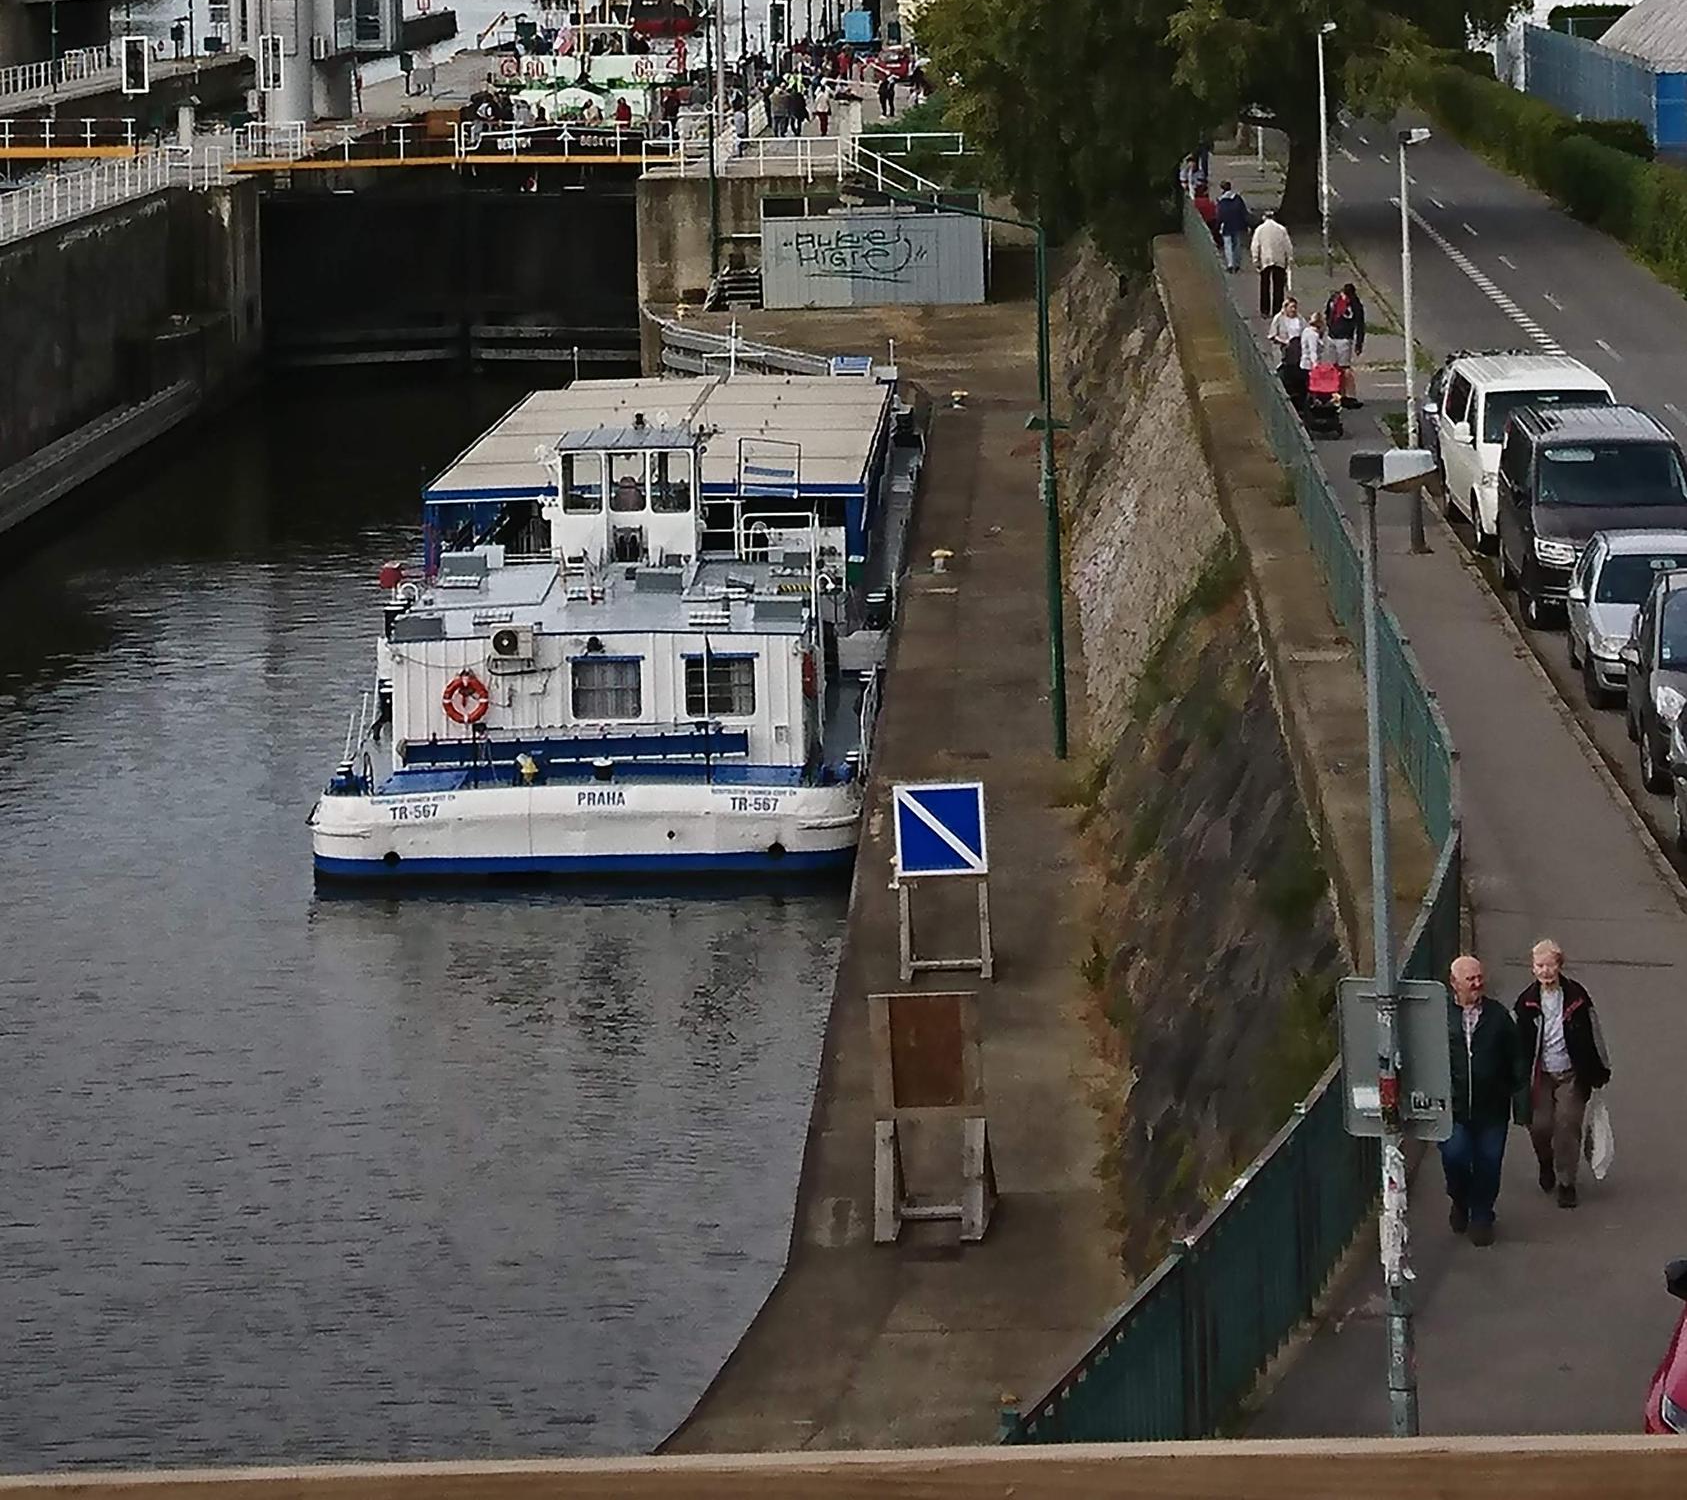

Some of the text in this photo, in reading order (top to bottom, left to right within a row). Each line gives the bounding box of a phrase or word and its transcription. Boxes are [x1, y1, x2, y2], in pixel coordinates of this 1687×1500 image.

[578, 791, 626, 806] PRAHA
[729, 796, 779, 812] TR-567
[389, 803, 439, 821] TR-567
